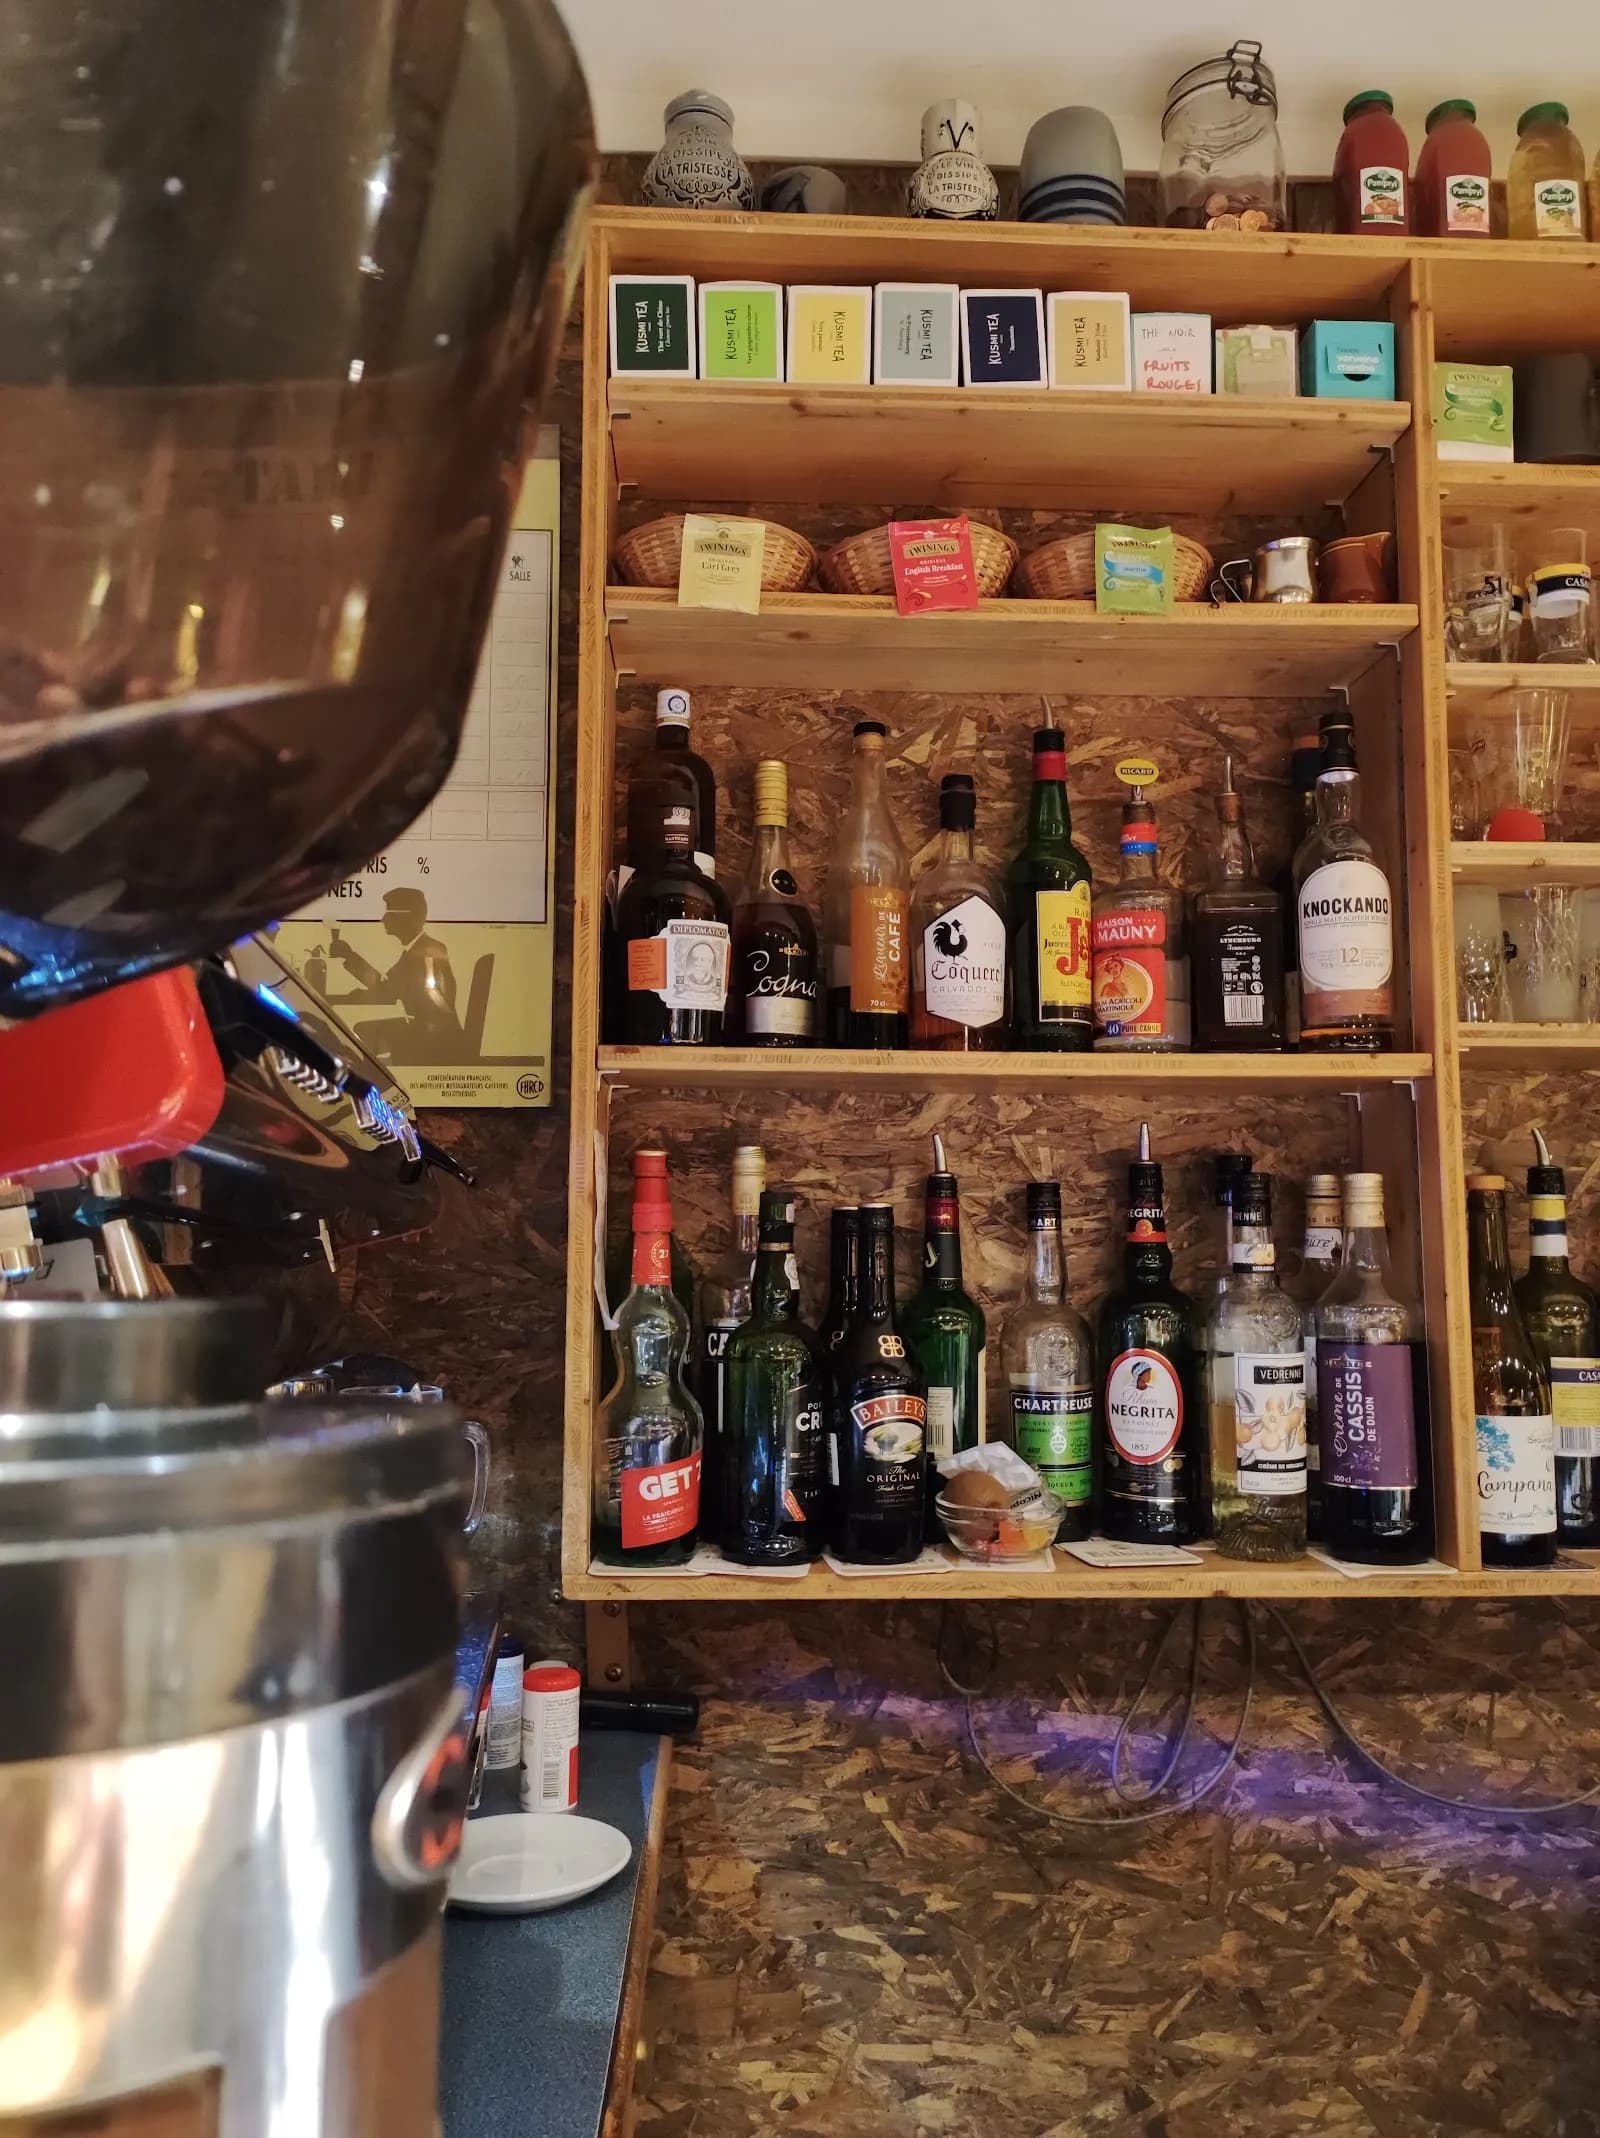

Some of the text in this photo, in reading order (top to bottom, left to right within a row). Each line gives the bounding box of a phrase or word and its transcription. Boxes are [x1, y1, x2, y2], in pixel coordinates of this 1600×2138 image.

[662, 161, 733, 181] LA TRISTESSE
[936, 170, 978, 181] DISSIPE
[928, 185, 940, 195] LA
[1367, 179, 1398, 189] Pampryl
[1453, 186, 1483, 196] Pampryl
[1541, 191, 1573, 202] Pampryl
[635, 300, 649, 353] KUSMI TEA
[1167, 327, 1197, 339] NOIR
[724, 308, 738, 360] KUSMI TEA
[832, 311, 846, 362] KUSMI TEA
[919, 309, 934, 361] KUSMI TEA
[986, 313, 1003, 365] KUSMI TEA
[1073, 316, 1088, 367] KUSMI TEA
[1143, 360, 1191, 372] FRUITS
[698, 543, 748, 557] TWININGS
[907, 543, 956, 557] TWININGS
[701, 561, 720, 571] Earl
[904, 566, 931, 576] English
[509, 570, 532, 582] SALLE
[1121, 767, 1153, 775] RICARD
[327, 880, 363, 898] NETS
[1303, 897, 1389, 919] KNOCKANDO
[1098, 925, 1157, 943] MAUNY
[1341, 947, 1360, 963] 12
[870, 999, 879, 1007] 70
[1107, 1023, 1119, 1036] 40
[658, 1248, 669, 1259] 27
[1260, 1368, 1302, 1380] VEDRENNE
[1335, 1377, 1342, 1388] DE
[858, 1399, 927, 1422] BAILEYS
[1013, 1396, 1093, 1412] CHARTREUSE
[1345, 1372, 1365, 1442] CASSIS
[1111, 1403, 1175, 1420] NEGRITA
[1365, 1396, 1377, 1442] DE DIJON
[866, 1471, 921, 1483] ORIGINAL
[888, 1465, 907, 1475] The
[638, 1465, 693, 1501] GET
